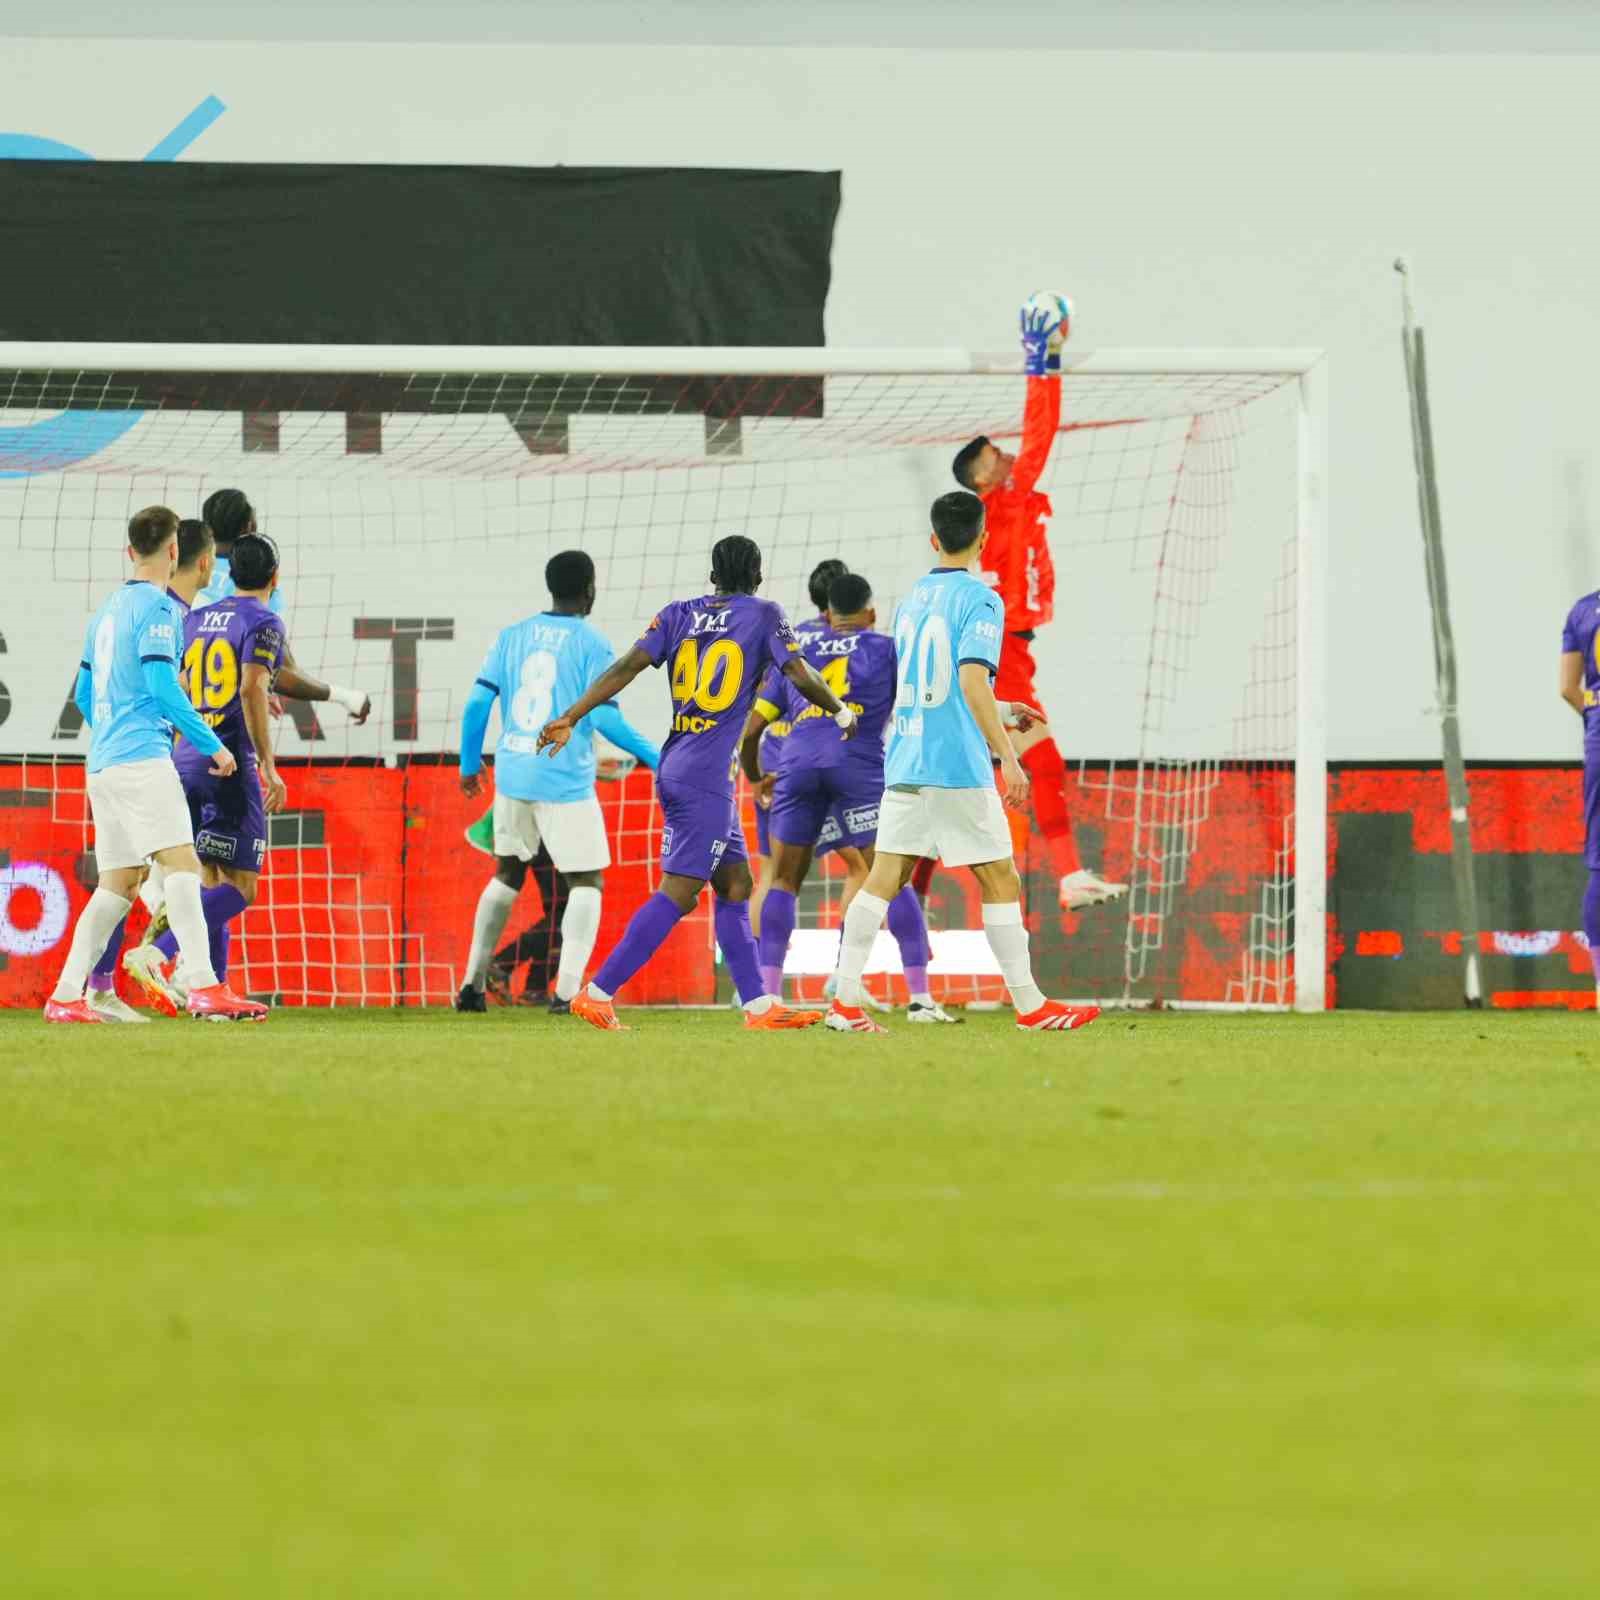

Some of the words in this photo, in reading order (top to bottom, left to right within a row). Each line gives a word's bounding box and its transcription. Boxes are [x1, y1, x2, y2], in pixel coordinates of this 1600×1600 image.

[203, 611, 235, 626] YKT
[692, 610, 732, 629] YKT
[816, 635, 861, 654] YKT
[184, 637, 238, 709] 19
[671, 638, 744, 713] 40
[819, 656, 850, 699] 4
[894, 614, 952, 709] 20
[512, 650, 557, 731] 8
